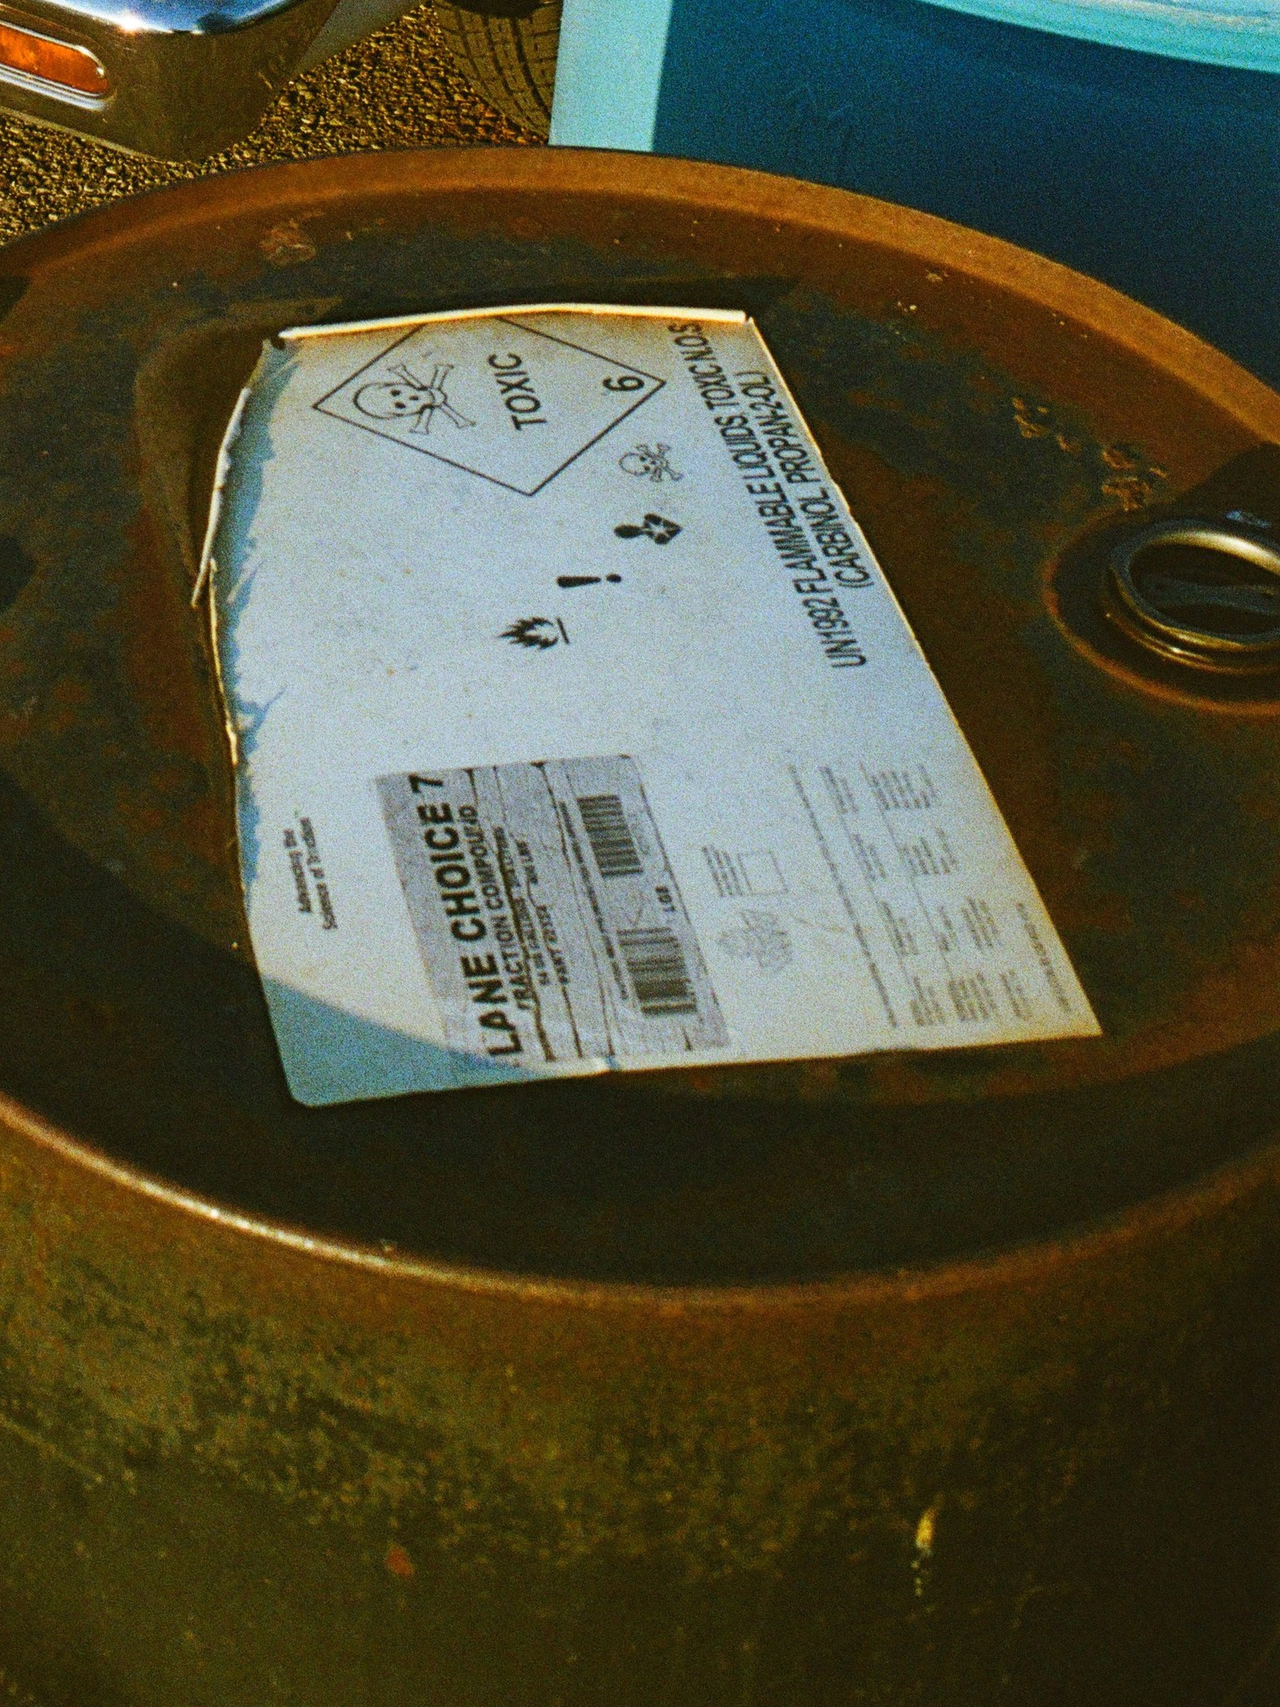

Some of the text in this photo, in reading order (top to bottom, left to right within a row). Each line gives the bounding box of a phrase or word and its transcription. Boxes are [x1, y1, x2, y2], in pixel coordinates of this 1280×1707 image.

[488, 352, 547, 431] TOXIC
[602, 375, 645, 392] 6
[734, 370, 822, 485] PROPAN-2-OL)
[746, 481, 834, 594] FLAMMABLE
[802, 596, 867, 669] UN1992
[459, 804, 504, 910] COMPOUND
[408, 773, 523, 1057] LANE CHOICE 7
